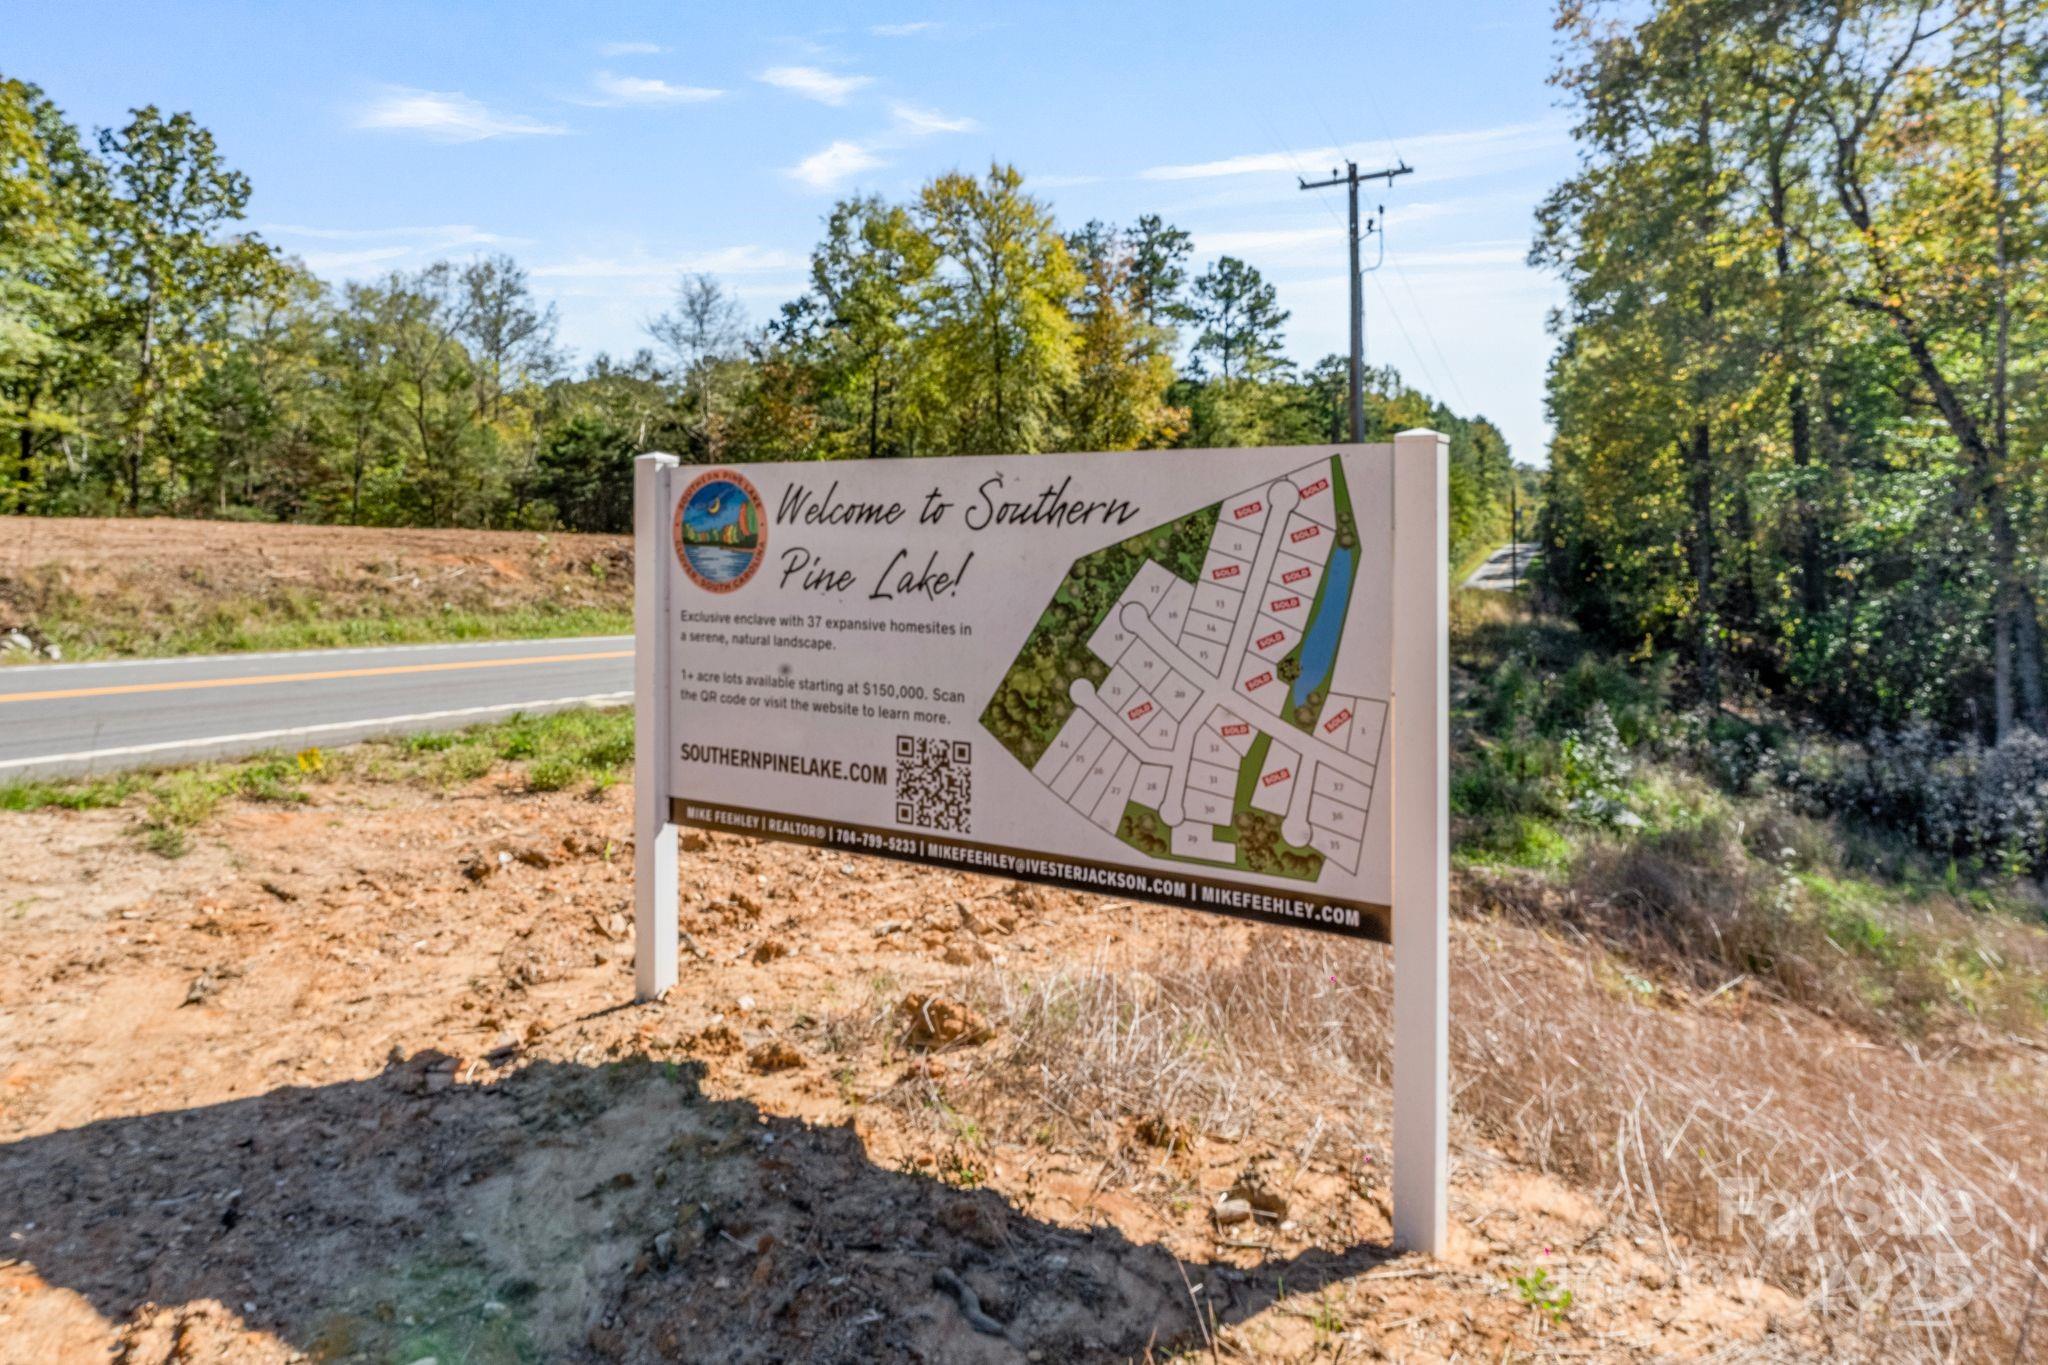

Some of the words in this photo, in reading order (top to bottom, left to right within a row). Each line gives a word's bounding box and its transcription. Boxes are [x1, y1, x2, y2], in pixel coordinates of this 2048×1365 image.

[1302, 479, 1328, 499] SOLD
[776, 480, 905, 526] Welcome
[919, 486, 954, 524] to
[965, 476, 1140, 530] Southern
[1236, 502, 1261, 519] SOLD
[1293, 526, 1319, 542] SOLD
[779, 546, 855, 591] Pine
[868, 548, 974, 600] Lake!
[1214, 565, 1239, 579] SOLD
[1284, 568, 1310, 583] SOLD
[1273, 598, 1299, 612] SOLD
[681, 610, 731, 624] Exclusive
[734, 612, 776, 626] enclave
[780, 614, 804, 628] with
[808, 615, 821, 628] 37
[826, 617, 886, 634] expansive
[890, 619, 956, 635] homesites
[960, 622, 972, 636] in
[681, 633, 686, 641] a
[689, 634, 728, 646] serene,
[732, 633, 770, 647] natural
[773, 634, 836, 652] landscape.
[1258, 631, 1283, 649] SOLD
[682, 669, 693, 681] 1+
[697, 673, 720, 683] acre
[723, 672, 743, 685] lots
[746, 675, 795, 689] available
[799, 677, 843, 696] starting
[847, 682, 859, 693] at
[862, 682, 928, 702] $150,000.
[933, 688, 965, 703] Scan
[1246, 672, 1271, 690] SOLD
[681, 689, 697, 700] the
[700, 690, 717, 703] QR
[720, 691, 746, 705] code
[749, 696, 761, 706] or
[764, 694, 788, 709] visit
[791, 697, 809, 711] the
[812, 699, 859, 716] website
[862, 705, 875, 718] to
[878, 705, 910, 720] learn
[914, 711, 951, 725] more.
[1129, 702, 1152, 719] SOLD
[1325, 709, 1350, 732] SOLD
[1222, 725, 1248, 736] SOLD
[681, 743, 888, 786] SOUTHERNPINELAKE.COM
[1264, 769, 1289, 786] SOLD
[687, 806, 713, 822] MIKE
[714, 810, 760, 830] FEEHLEY
[928, 843, 1187, 898] MIKEFEEHLEY@IVESTERJACKSON.COM
[1201, 886, 1360, 927] MIKEFEEHLEY.COM
